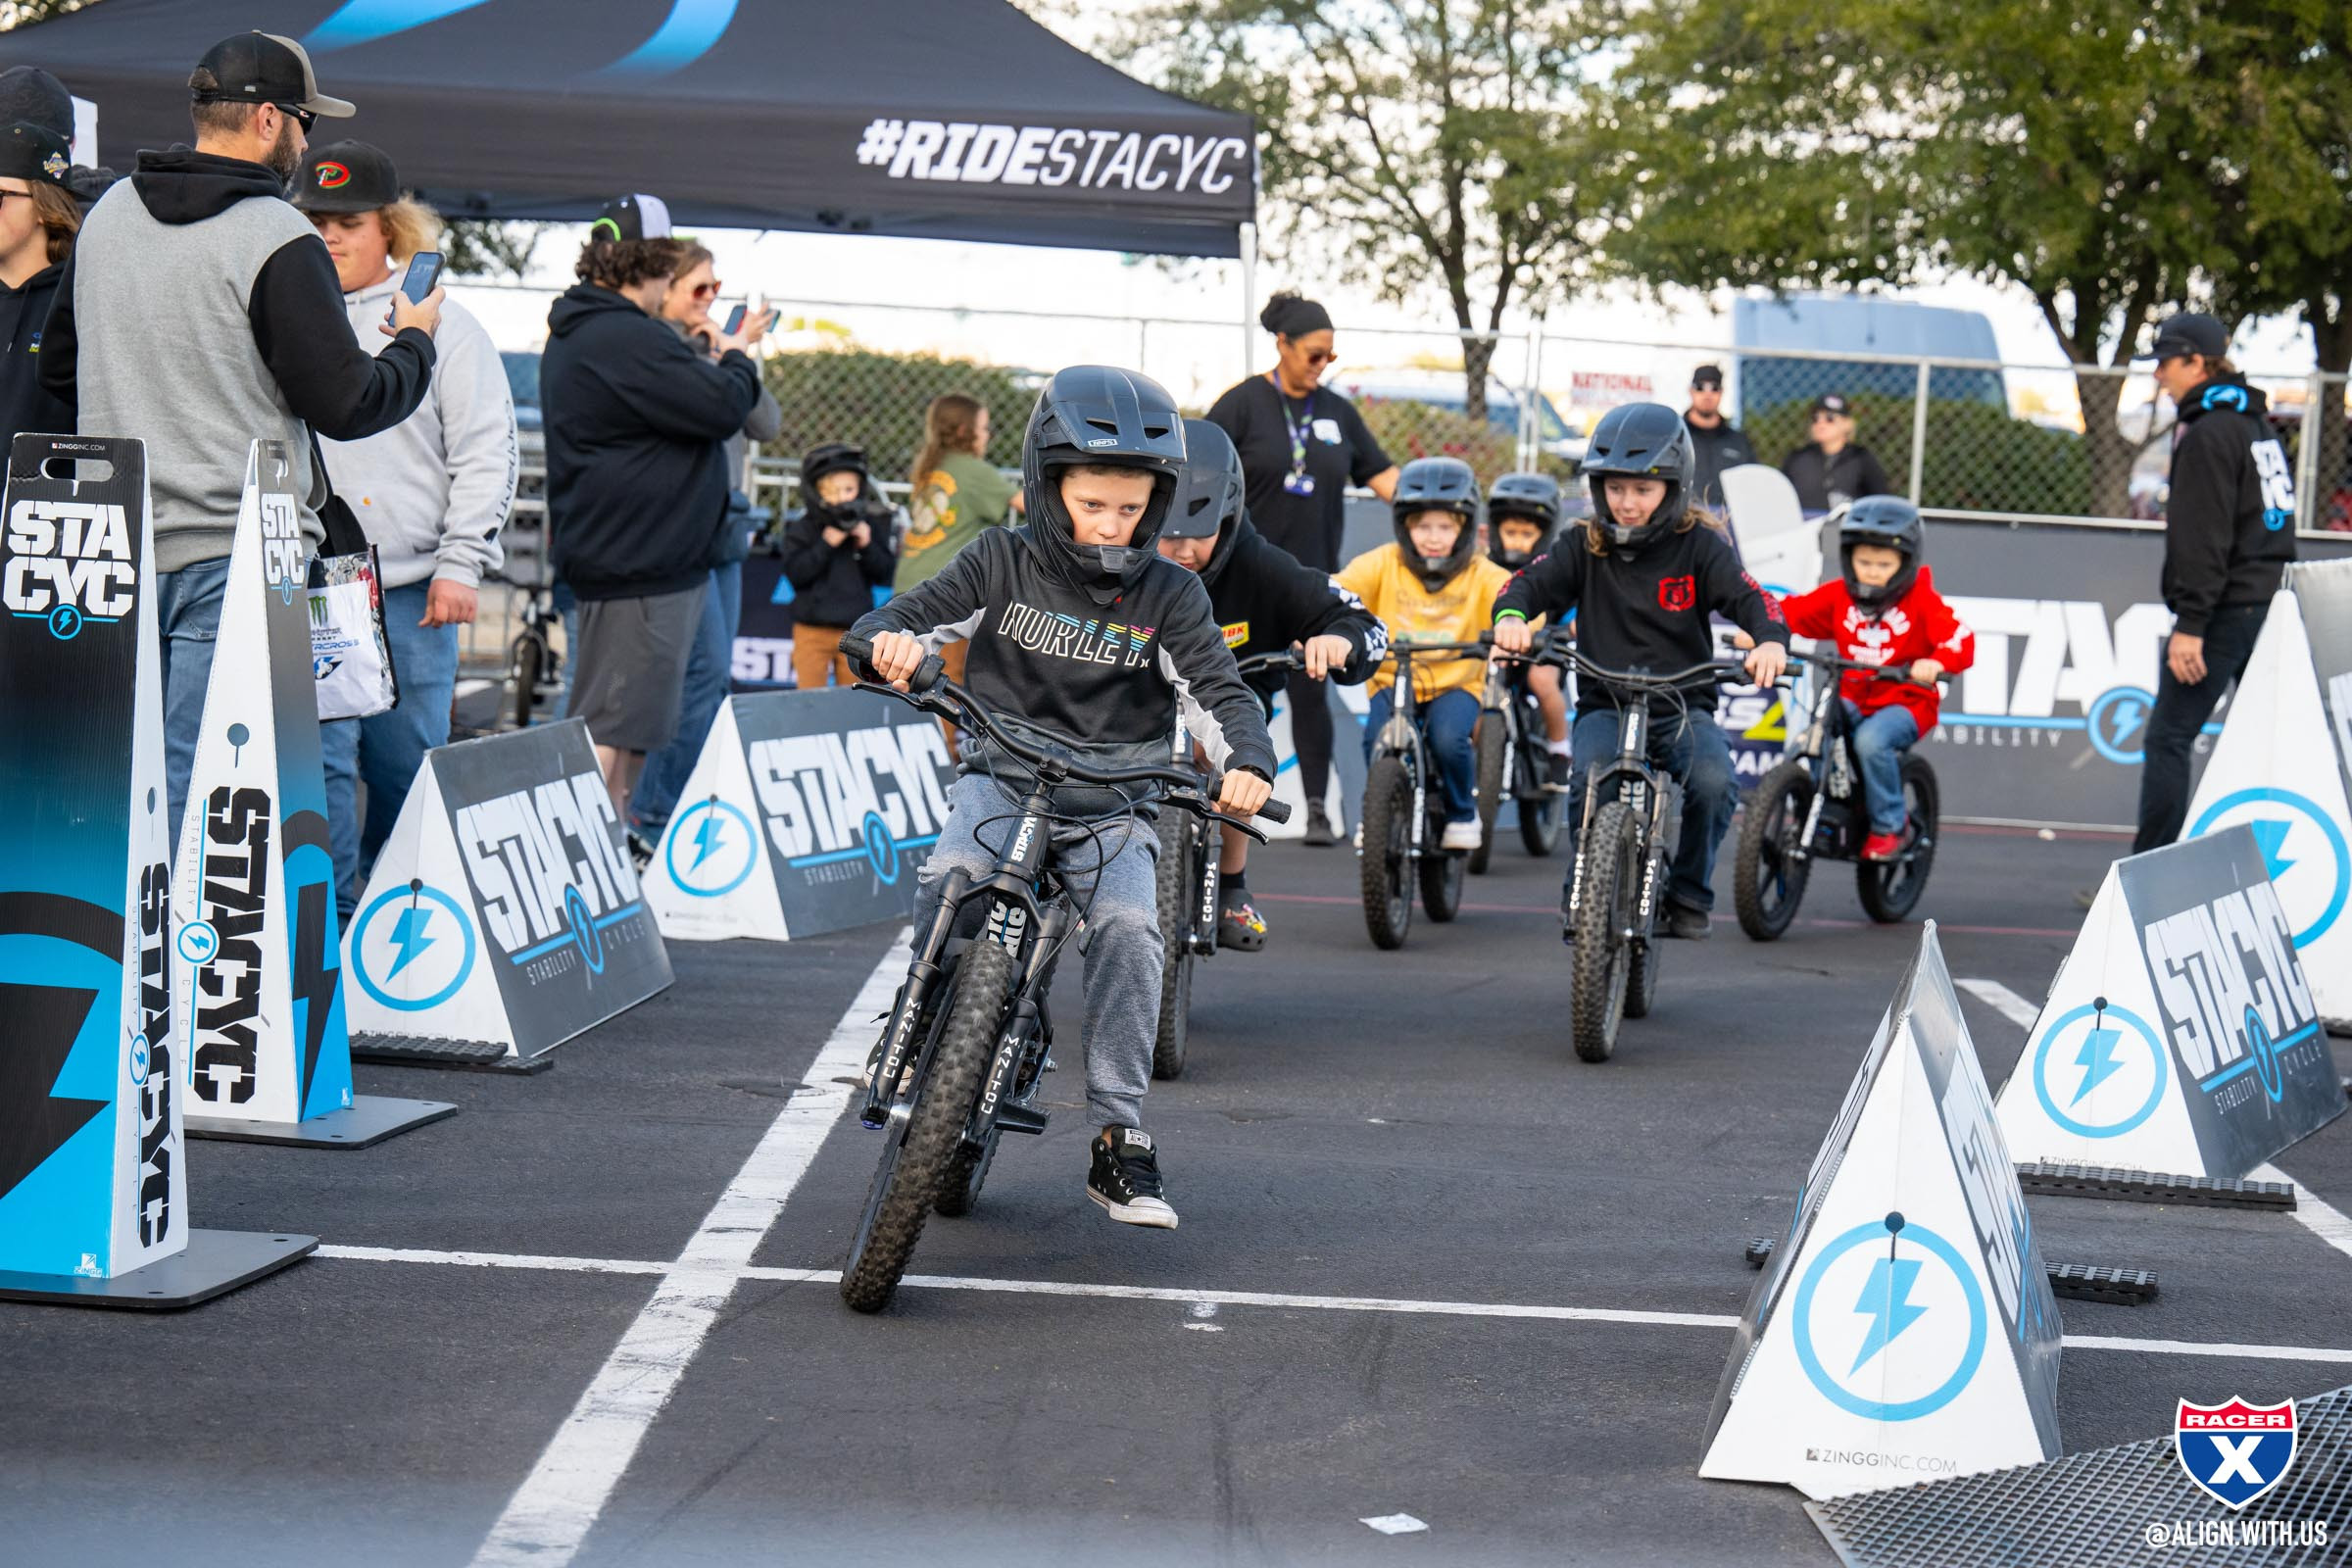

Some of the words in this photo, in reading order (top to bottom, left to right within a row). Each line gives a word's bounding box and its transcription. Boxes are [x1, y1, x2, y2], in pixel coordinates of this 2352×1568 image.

[857, 119, 1247, 194] #RIDESTACYC
[1572, 371, 1653, 393] NATIONAL
[8, 500, 131, 560] STA
[262, 493, 301, 538] STA
[3, 556, 135, 616] CYC
[264, 539, 305, 584] CYC
[312, 639, 360, 650] RCROSS
[998, 600, 1156, 666] HURLEY
[1927, 725, 2062, 747] ABILITY
[749, 723, 951, 858] STACYC
[186, 814, 200, 906] STABILITY
[456, 771, 640, 954] STACYC
[1011, 811, 1038, 862] STACY
[804, 860, 863, 886] STABILITY
[1194, 862, 1217, 923] MANITOU
[194, 786, 270, 1104] STACYC
[526, 949, 576, 986] STABILITY
[605, 917, 646, 950] CYCLE
[2144, 881, 2316, 1080] STACYC
[140, 862, 171, 1249] STACYC
[178, 978, 191, 1066] CYCLE
[882, 997, 922, 1079] MANITOU
[981, 1033, 1020, 1114] MANITOU
[2215, 1075, 2258, 1114] STABILITY
[2283, 1039, 2322, 1075] CYCLE
[1823, 1449, 1957, 1473] ZINGGINC.COM
